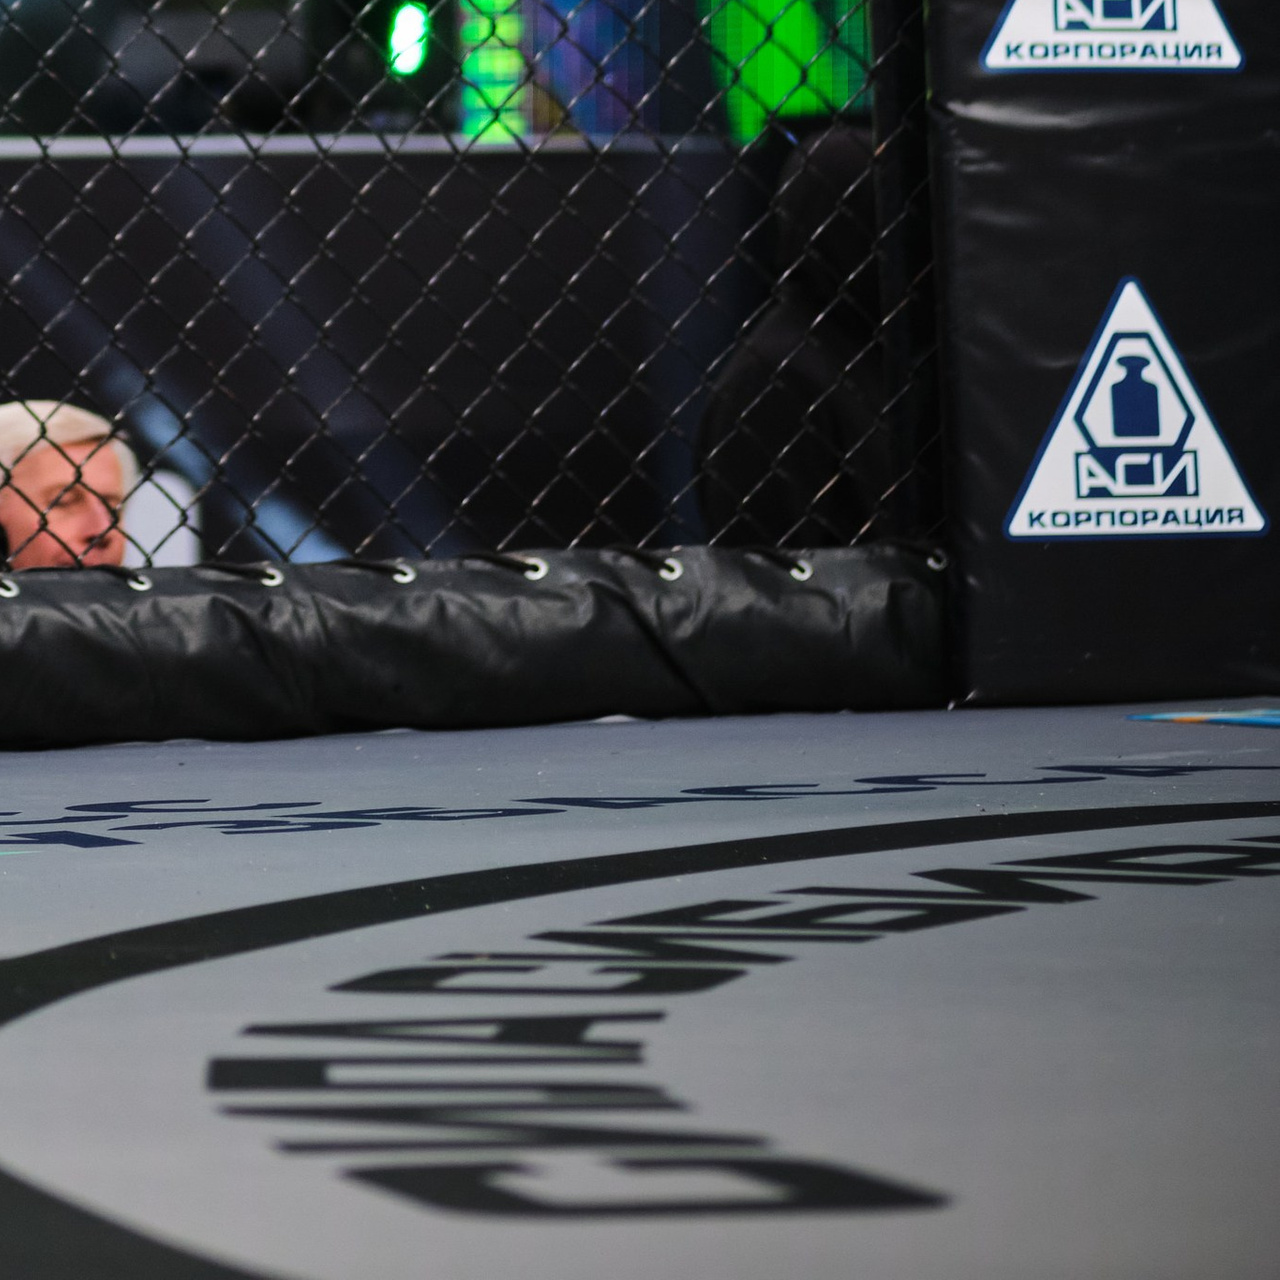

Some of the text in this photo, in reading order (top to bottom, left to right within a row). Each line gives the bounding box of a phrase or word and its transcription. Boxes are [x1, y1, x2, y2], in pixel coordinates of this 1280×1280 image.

[1005, 41, 1223, 65] КОРПОРАЦИЯ
[1078, 452, 1197, 496] АСИ
[1028, 507, 1245, 530] КОРПОРАЦИЯ
